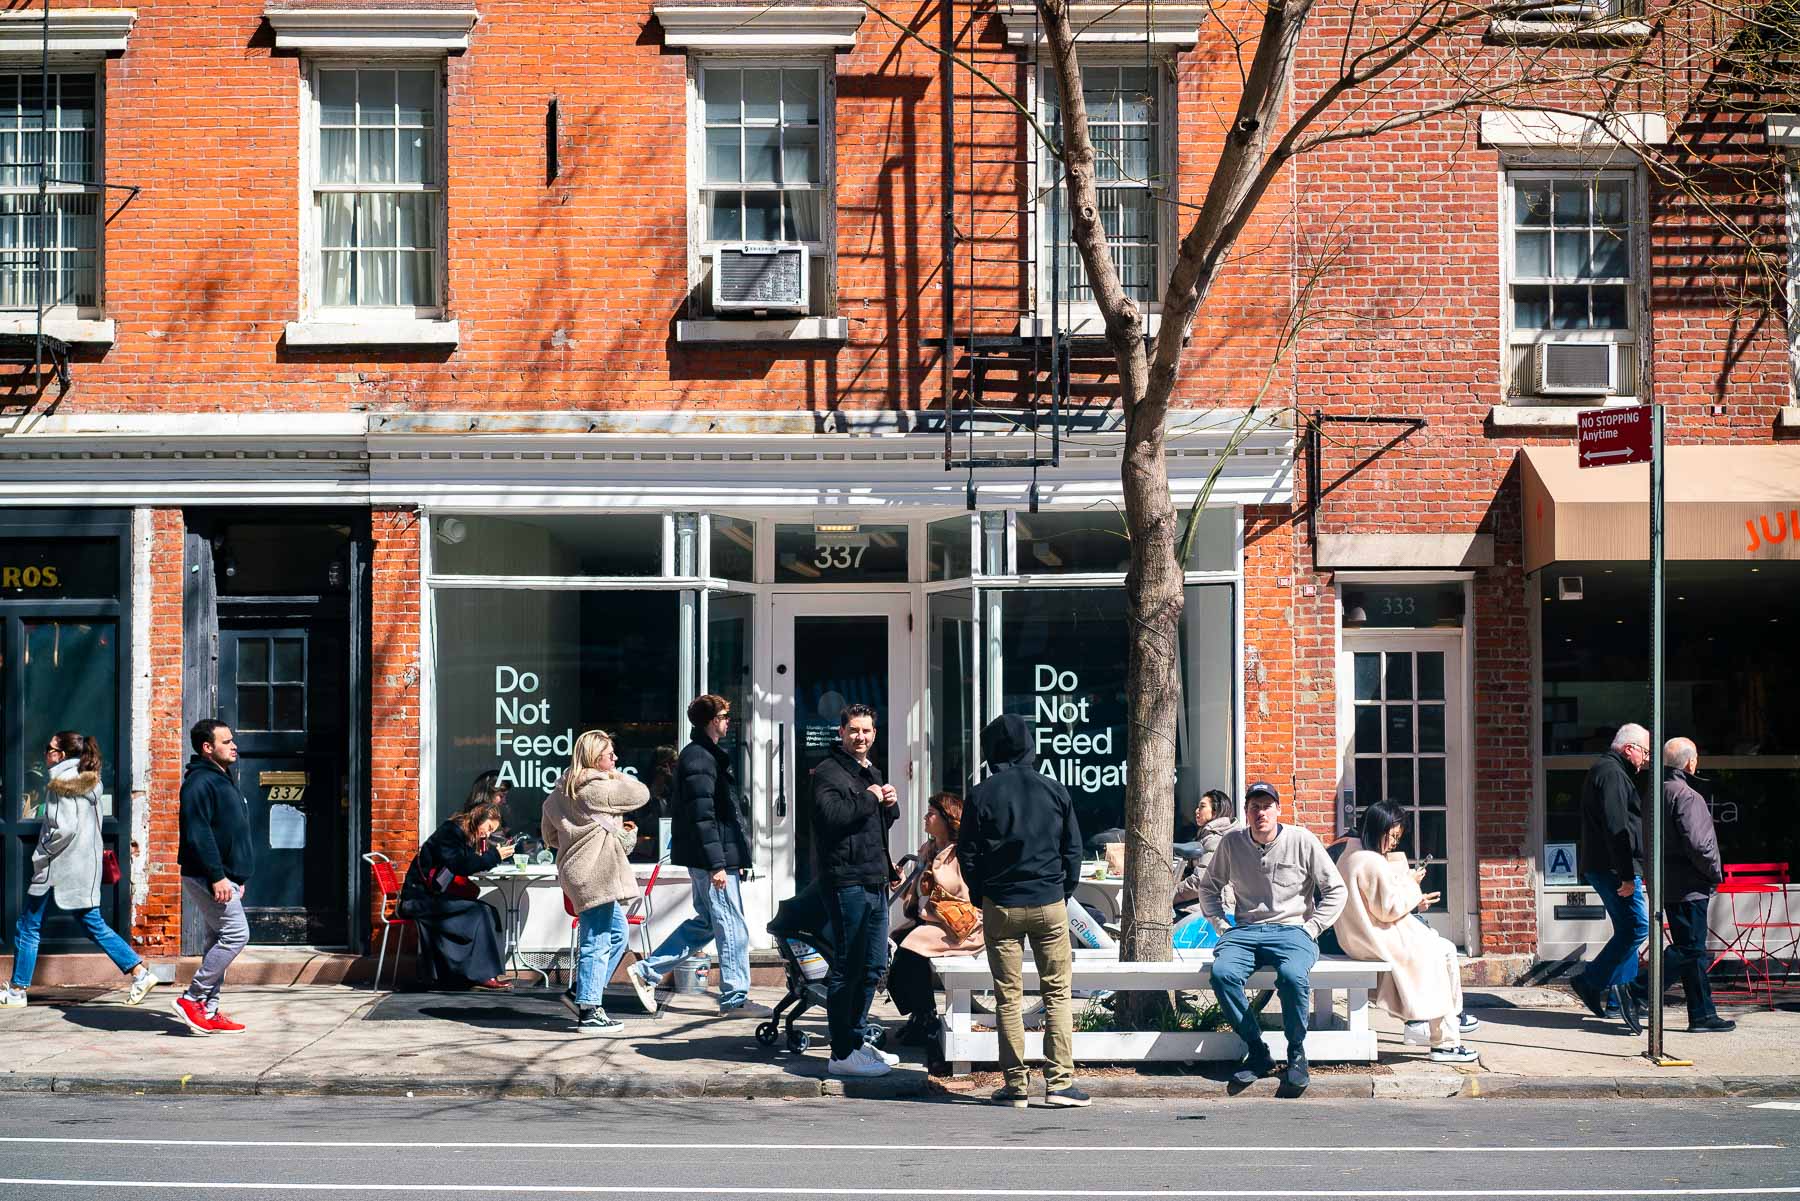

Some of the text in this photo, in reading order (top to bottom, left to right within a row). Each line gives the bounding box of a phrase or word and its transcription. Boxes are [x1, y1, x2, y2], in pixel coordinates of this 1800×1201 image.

[1581, 412, 1640, 429] NO STOPPING
[1582, 428, 1619, 443] Anytime
[814, 544, 867, 569] 337
[1382, 596, 1415, 615] 333
[495, 665, 540, 693] Do
[1035, 664, 1078, 692] Do
[495, 697, 551, 725] Not
[1035, 695, 1090, 723] Not
[495, 728, 573, 757] Feed
[1035, 727, 1112, 755] Feed
[1038, 758, 1178, 793] Alligat
[271, 786, 304, 800] 337
[1550, 848, 1572, 873] A
[1070, 918, 1087, 933] citi
